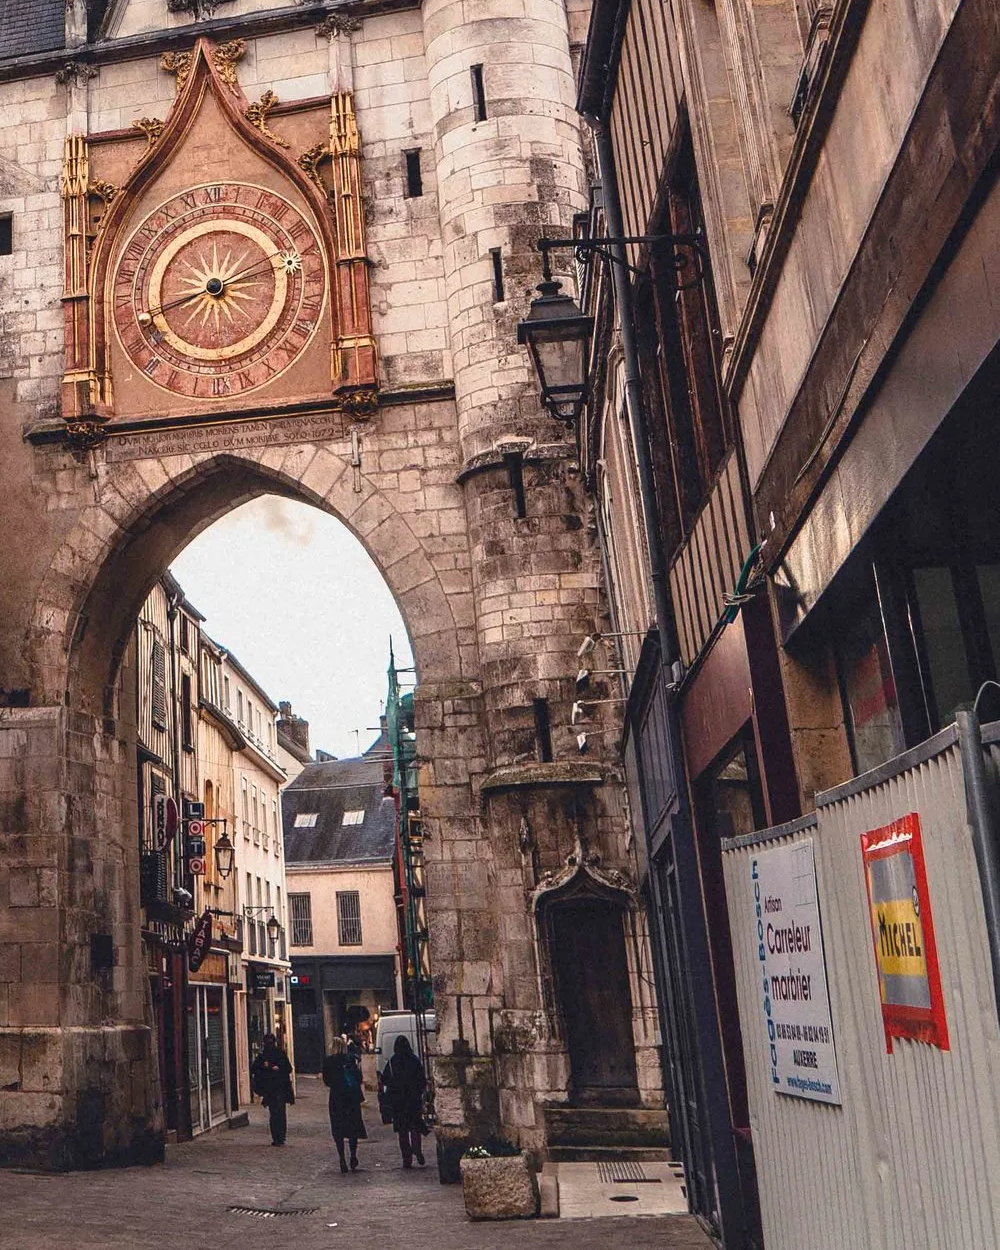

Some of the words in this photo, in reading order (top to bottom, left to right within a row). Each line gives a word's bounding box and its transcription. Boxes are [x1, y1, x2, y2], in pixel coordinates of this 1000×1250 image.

[160, 207, 178, 223] X
[764, 896, 783, 913] Artisan
[766, 919, 812, 955] Carreleur
[877, 909, 922, 958] MICHEL
[771, 967, 812, 1001] marbrier
[793, 1049, 818, 1069] AUXERRE
